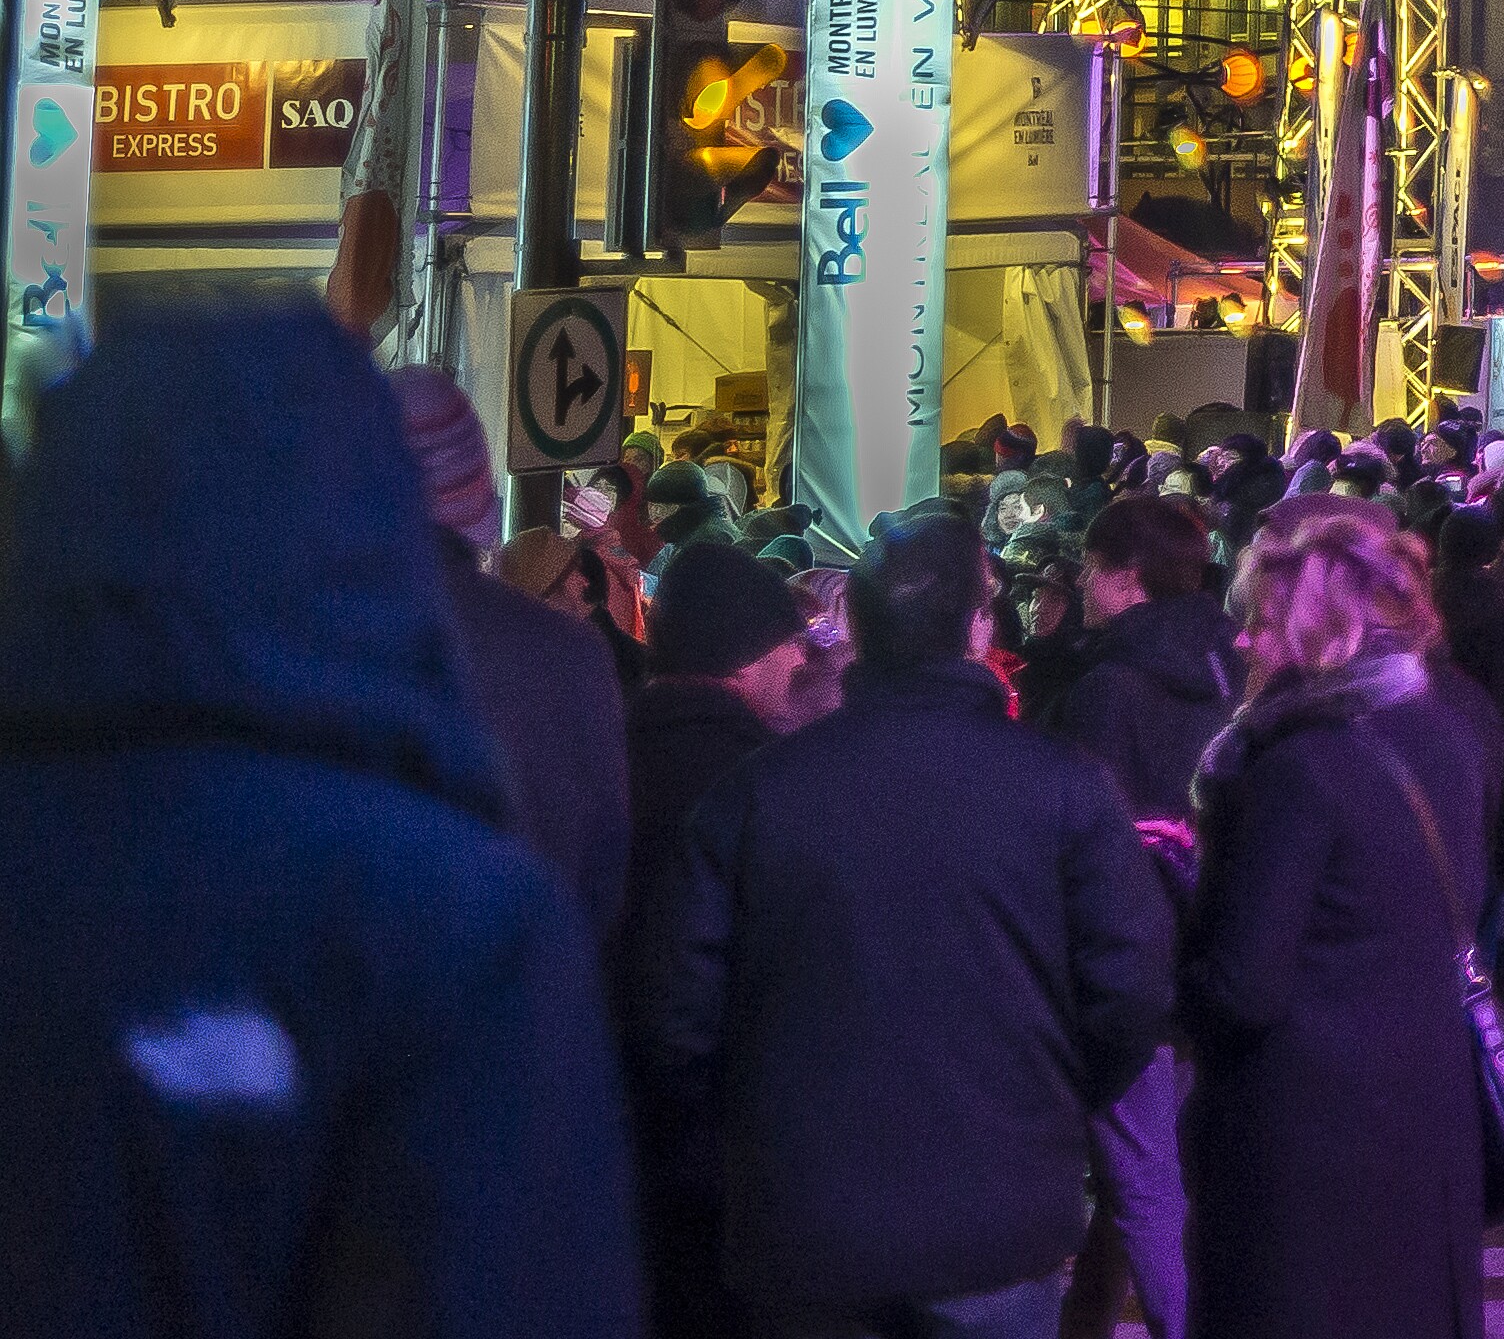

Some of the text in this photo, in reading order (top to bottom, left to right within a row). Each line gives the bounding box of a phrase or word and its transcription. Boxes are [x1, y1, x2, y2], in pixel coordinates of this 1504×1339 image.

[65, 36, 86, 74] EN
[854, 45, 876, 80] EN
[911, 47, 934, 111] EN
[95, 81, 242, 123] BISTRO
[281, 98, 355, 130] SAQ
[112, 132, 218, 160] EXPRESS
[816, 181, 871, 287] Bell
